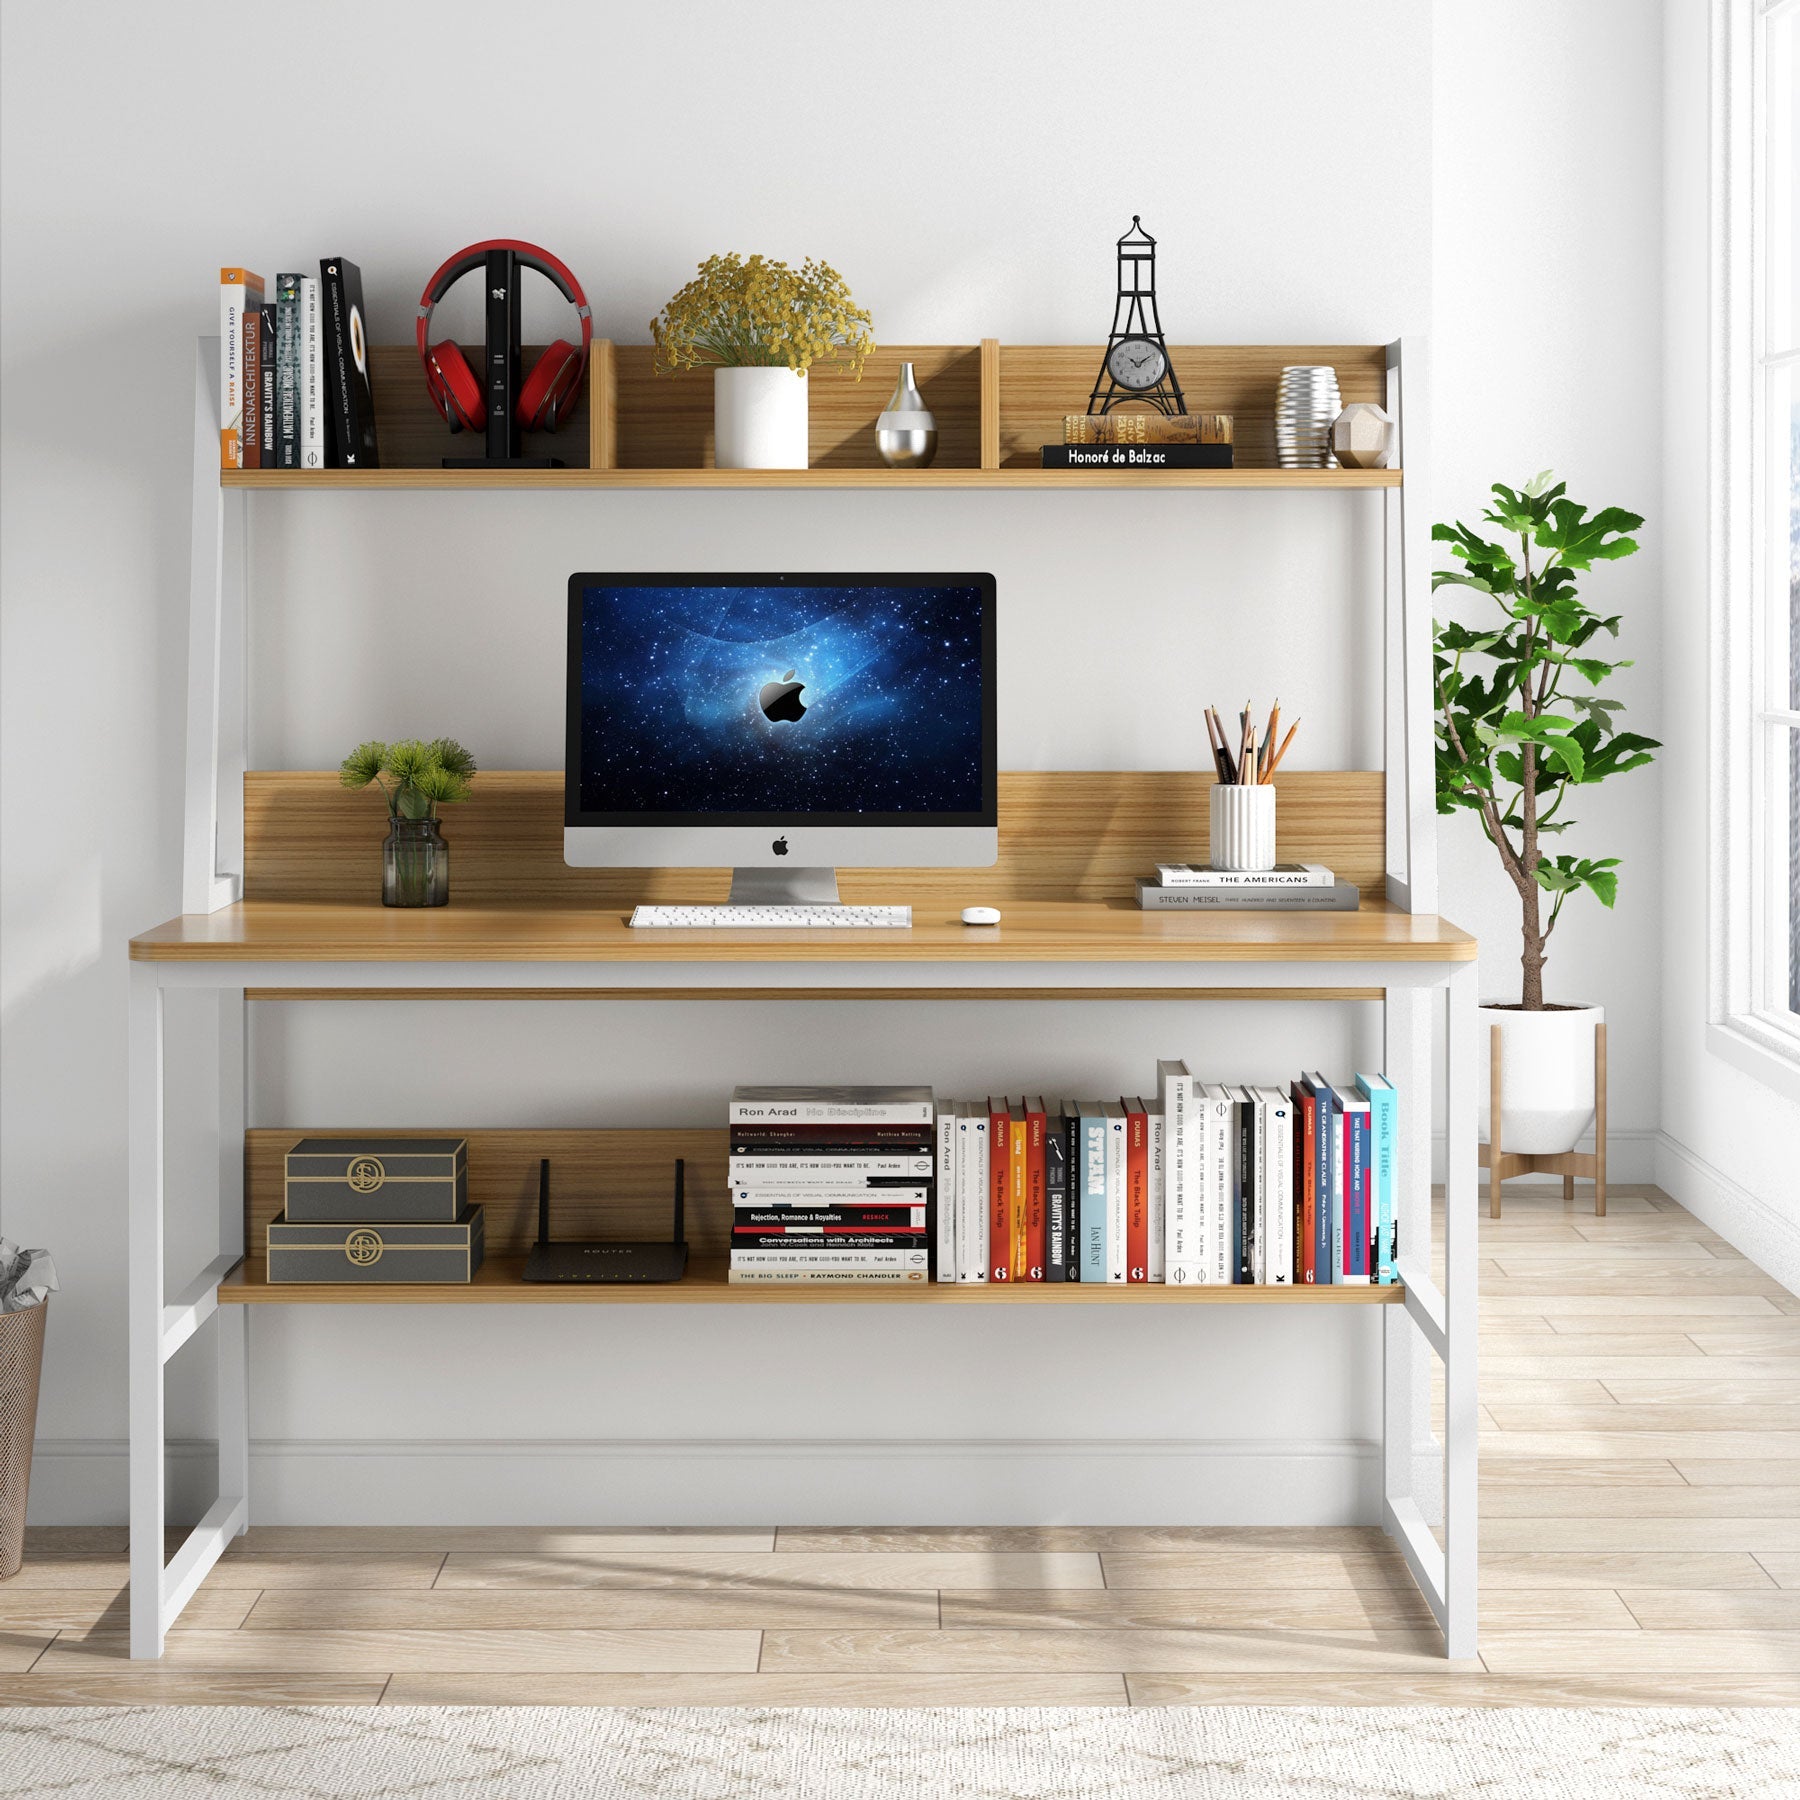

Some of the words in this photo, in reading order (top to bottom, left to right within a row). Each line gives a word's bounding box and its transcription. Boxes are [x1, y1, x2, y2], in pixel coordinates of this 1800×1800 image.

[245, 322, 256, 445] INNENARCHITEKTUR
[264, 371, 273, 412] GRAVITY'S
[283, 365, 294, 388] MOSAIC
[283, 390, 294, 434] MATHEMATICAL
[264, 413, 273, 450] RAINBOW
[1068, 449, 1108, 463] Honoré
[1112, 449, 1125, 463] de
[1129, 449, 1165, 463] Balzac
[1381, 1102, 1389, 1139] Book
[1088, 1127, 1105, 1195] STEAM
[1381, 1146, 1389, 1177] Title
[1051, 1194, 1062, 1230] GRAVITY'S
[1051, 1232, 1062, 1265] RAINBOW
